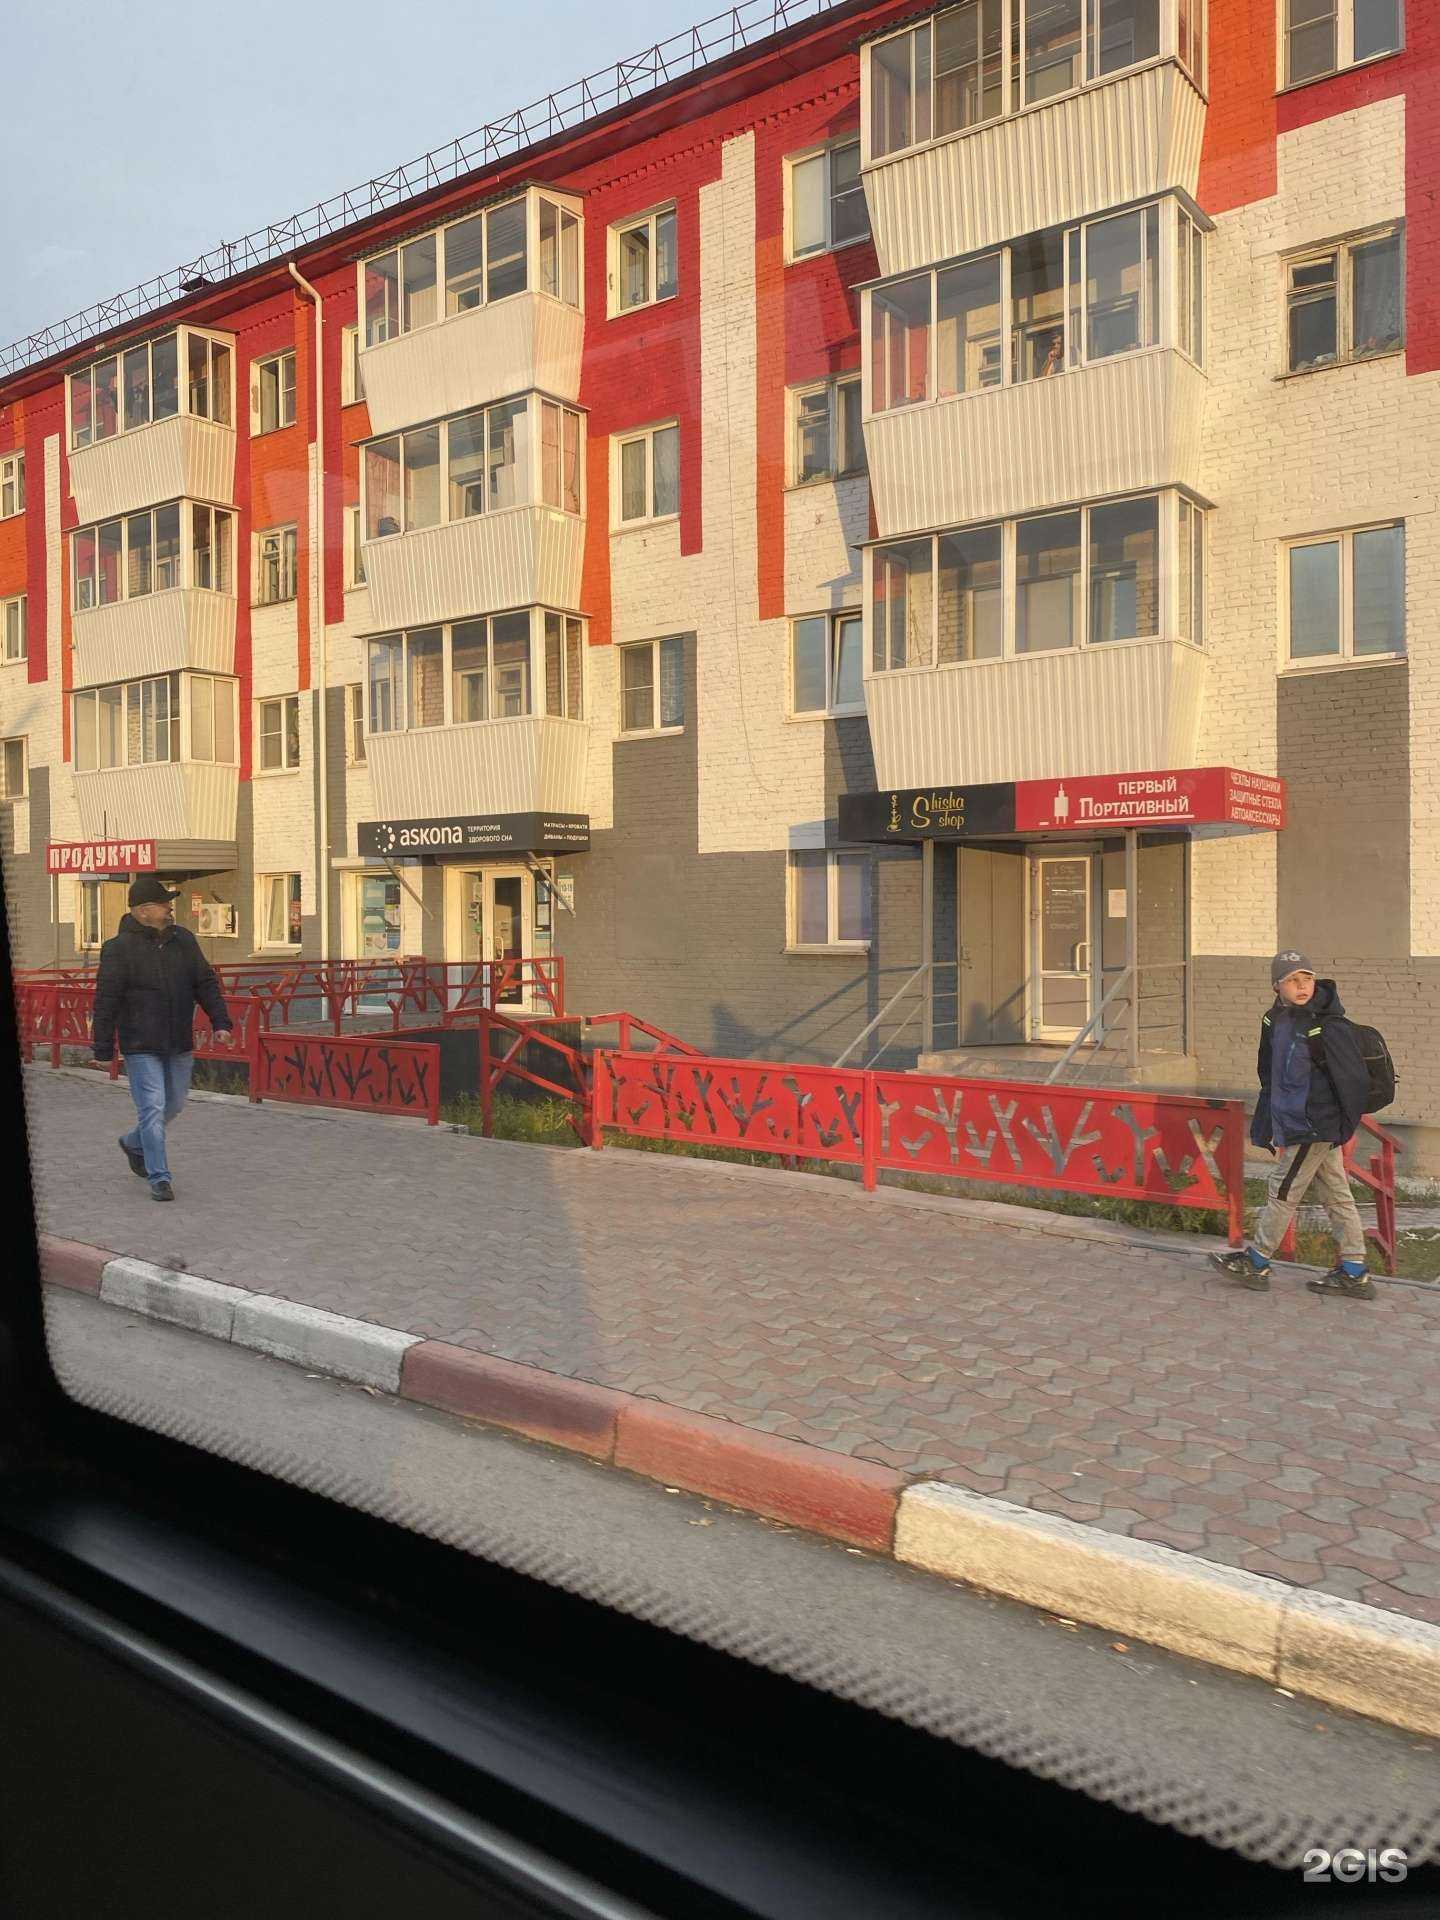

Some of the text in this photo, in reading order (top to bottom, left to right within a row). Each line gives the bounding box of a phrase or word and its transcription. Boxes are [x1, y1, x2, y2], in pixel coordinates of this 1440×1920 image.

[1118, 776, 1177, 795] ПЕРВЫЙ
[1230, 771, 1281, 794] ЧЕХЛЫ НАУШНИКИ
[1229, 788, 1282, 810] ЗАЩИТНЫЕ СТЕКЛА
[911, 792, 965, 828] Shisha
[938, 810, 965, 830] shop
[1231, 806, 1280, 825] АВТОАКСЕССУАРЫ
[400, 826, 463, 846] askona
[467, 824, 501, 833] ТЕРРИТОРИЯ
[501, 834, 513, 842] СНА
[49, 843, 152, 872] ПРОДУКТЫ
